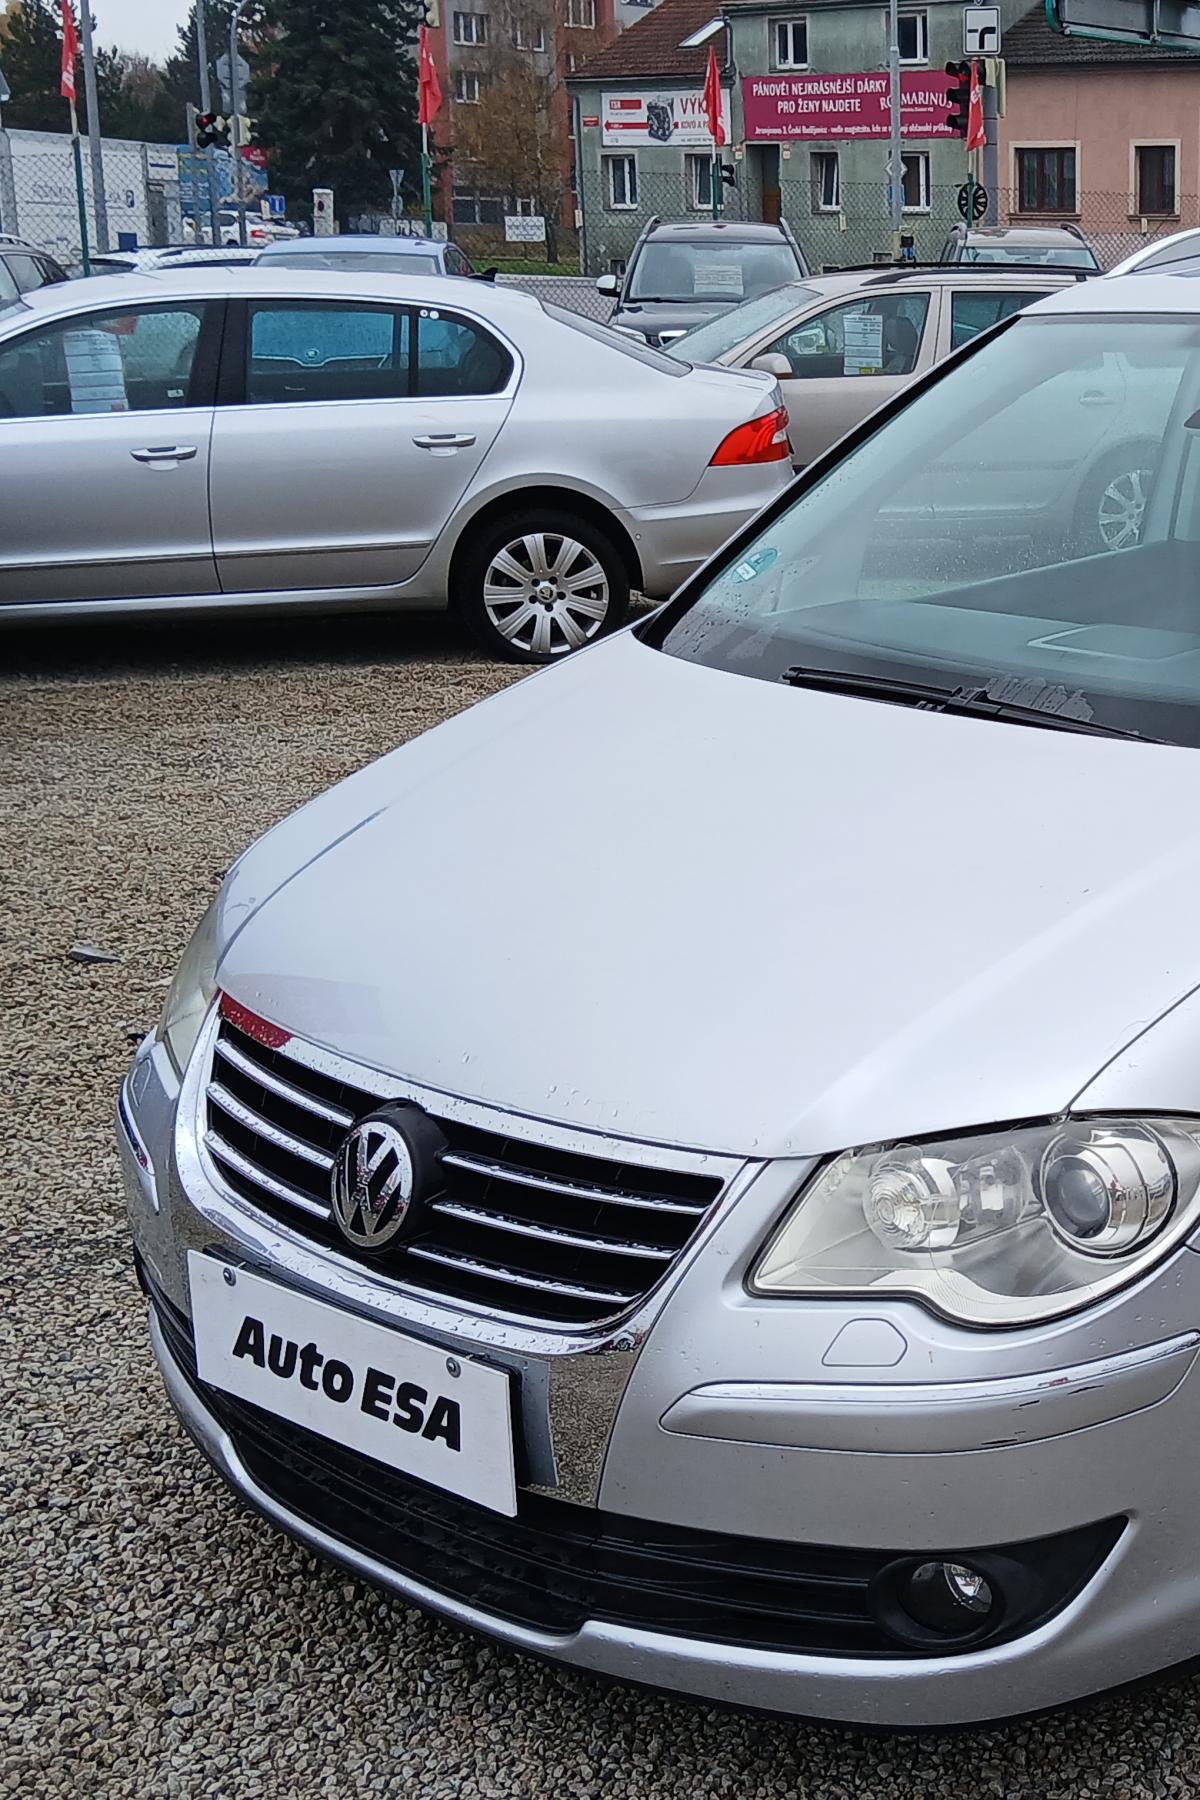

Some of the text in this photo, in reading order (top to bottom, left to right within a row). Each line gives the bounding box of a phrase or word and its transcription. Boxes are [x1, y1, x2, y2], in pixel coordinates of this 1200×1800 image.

[791, 78, 855, 96] NEJKRÁSNĚJŠÍ
[857, 79, 887, 94] DÁRKY
[680, 94, 707, 115] VÝK
[777, 98, 861, 114] PRO ŽENY NAJDETE
[231, 1315, 461, 1453] Auto ESA
